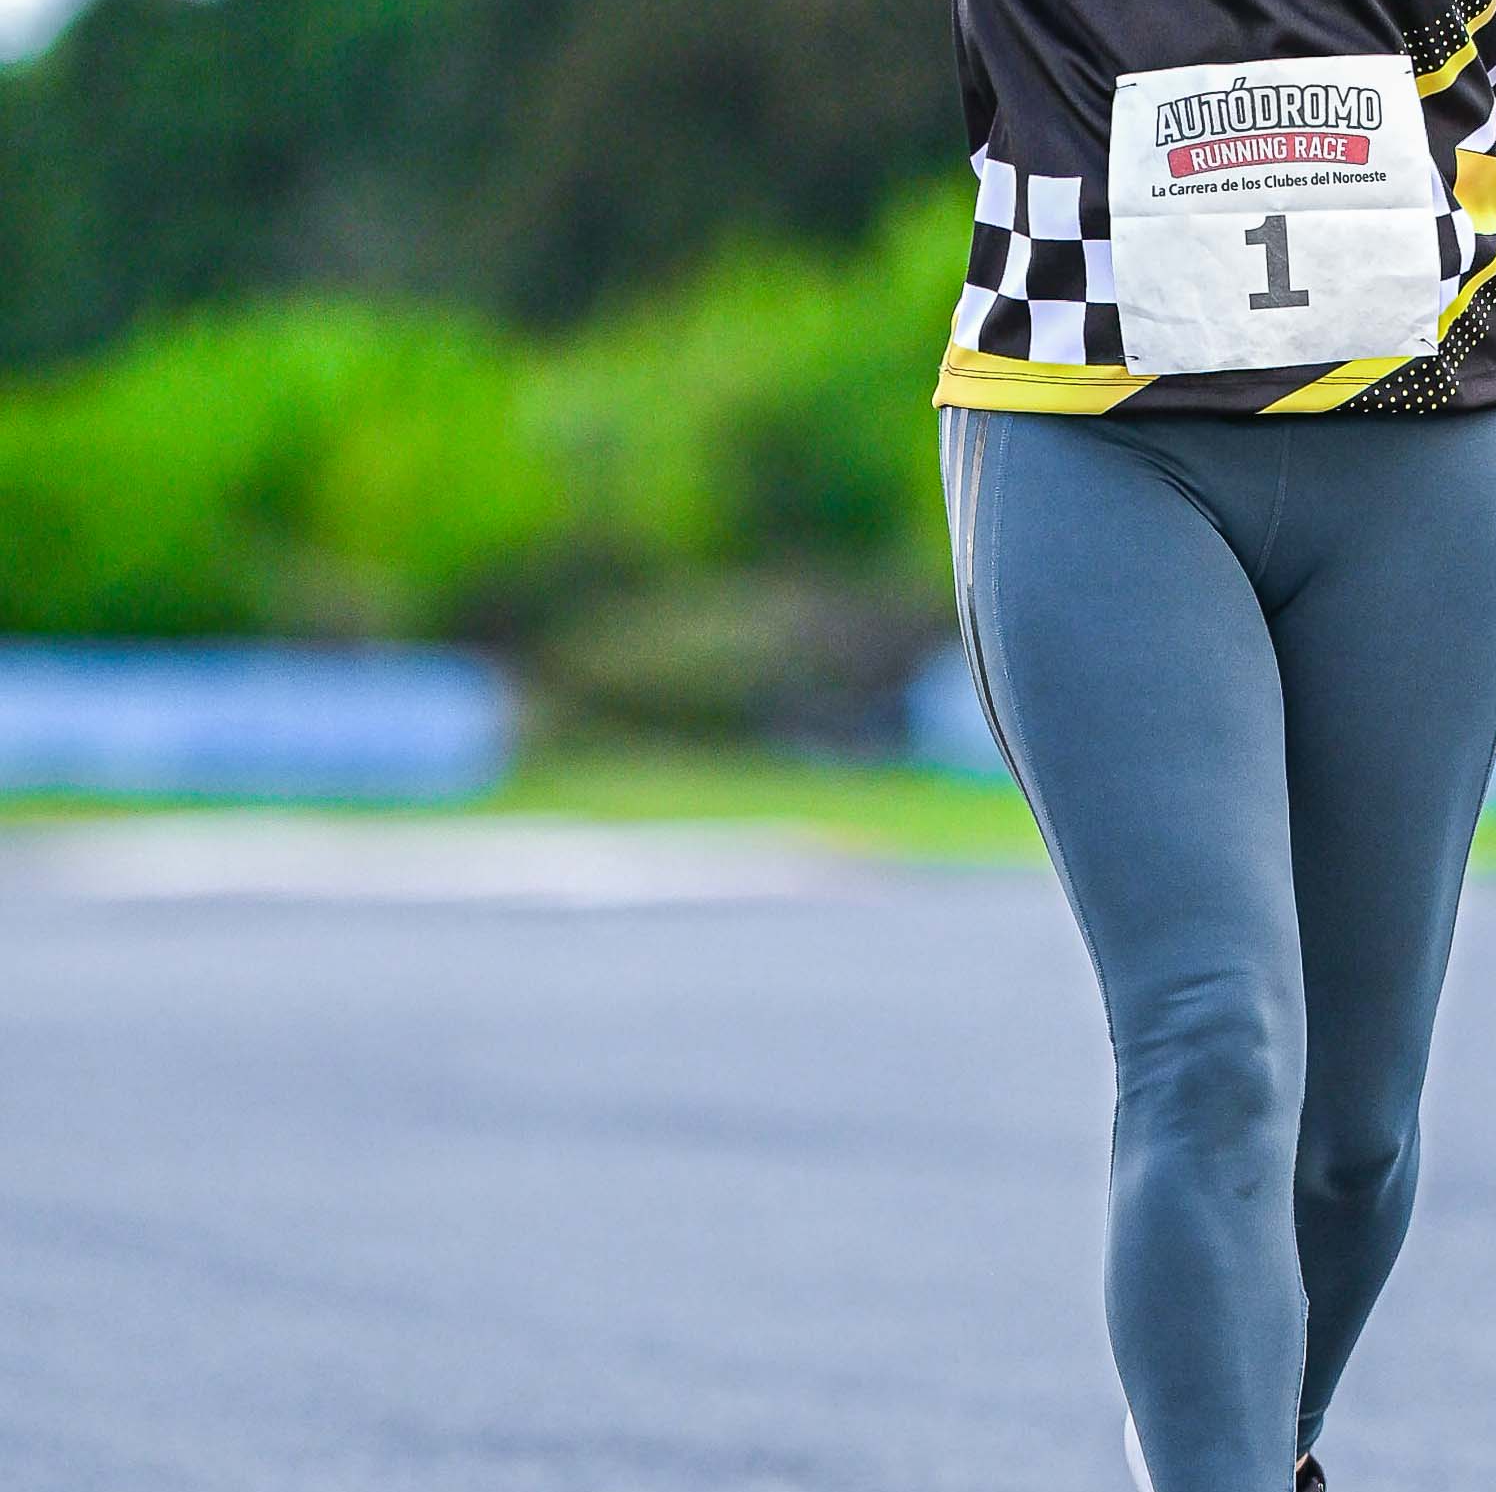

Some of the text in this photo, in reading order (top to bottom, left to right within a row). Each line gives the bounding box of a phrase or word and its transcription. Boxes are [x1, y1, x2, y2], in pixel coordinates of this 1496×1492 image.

[1155, 76, 1381, 145] AUTÓDROMO
[1189, 135, 1346, 171] RUNNING RACE
[1151, 170, 1385, 196] La Carrera de los Clubes del Noroeste
[1245, 214, 1308, 309] 1
